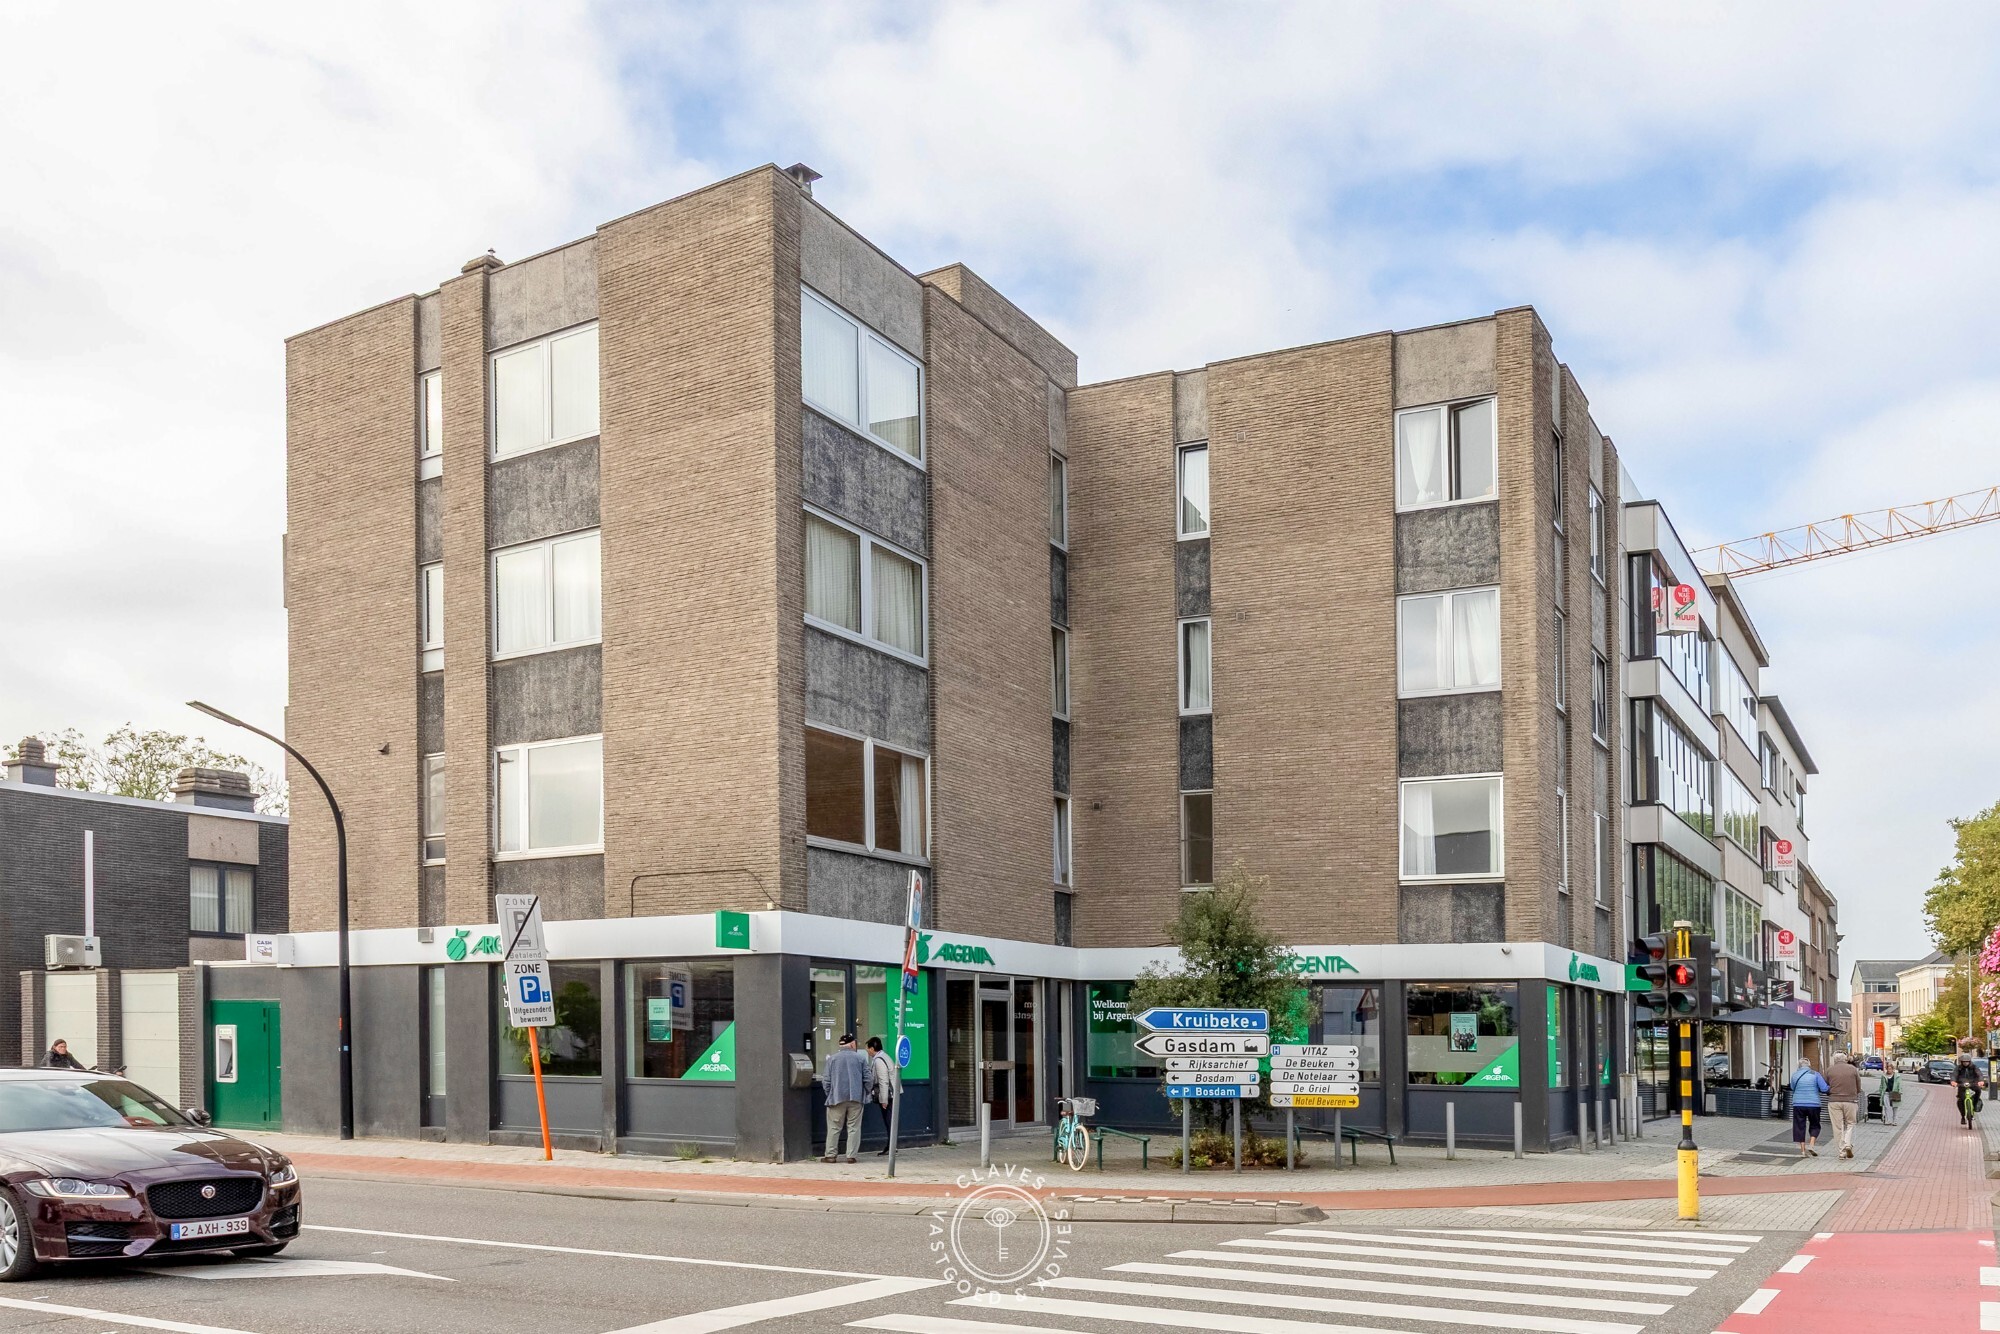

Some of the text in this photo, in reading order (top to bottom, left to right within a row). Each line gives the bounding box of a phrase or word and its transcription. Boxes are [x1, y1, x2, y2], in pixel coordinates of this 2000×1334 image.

[514, 963, 541, 974] ZONE
[513, 1006, 551, 1015] Uitgezonderd
[1092, 1011, 1104, 1022] bij
[1172, 1012, 1250, 1028] Kruibeke
[1165, 1038, 1236, 1053] Gasdam
[1302, 1046, 1329, 1056] VITAZ
[1188, 1059, 1249, 1072] Rijksarchief
[1285, 1058, 1335, 1068] De Beuken
[1195, 1073, 1235, 1084] Bosdam
[1282, 1071, 1338, 1081] De Notelaar
[1195, 1087, 1236, 1097] Bosdam
[1293, 1083, 1331, 1093] De Griel
[1295, 1095, 1347, 1106] Hotel Beveren
[181, 1220, 247, 1237] 2-AXH-939
